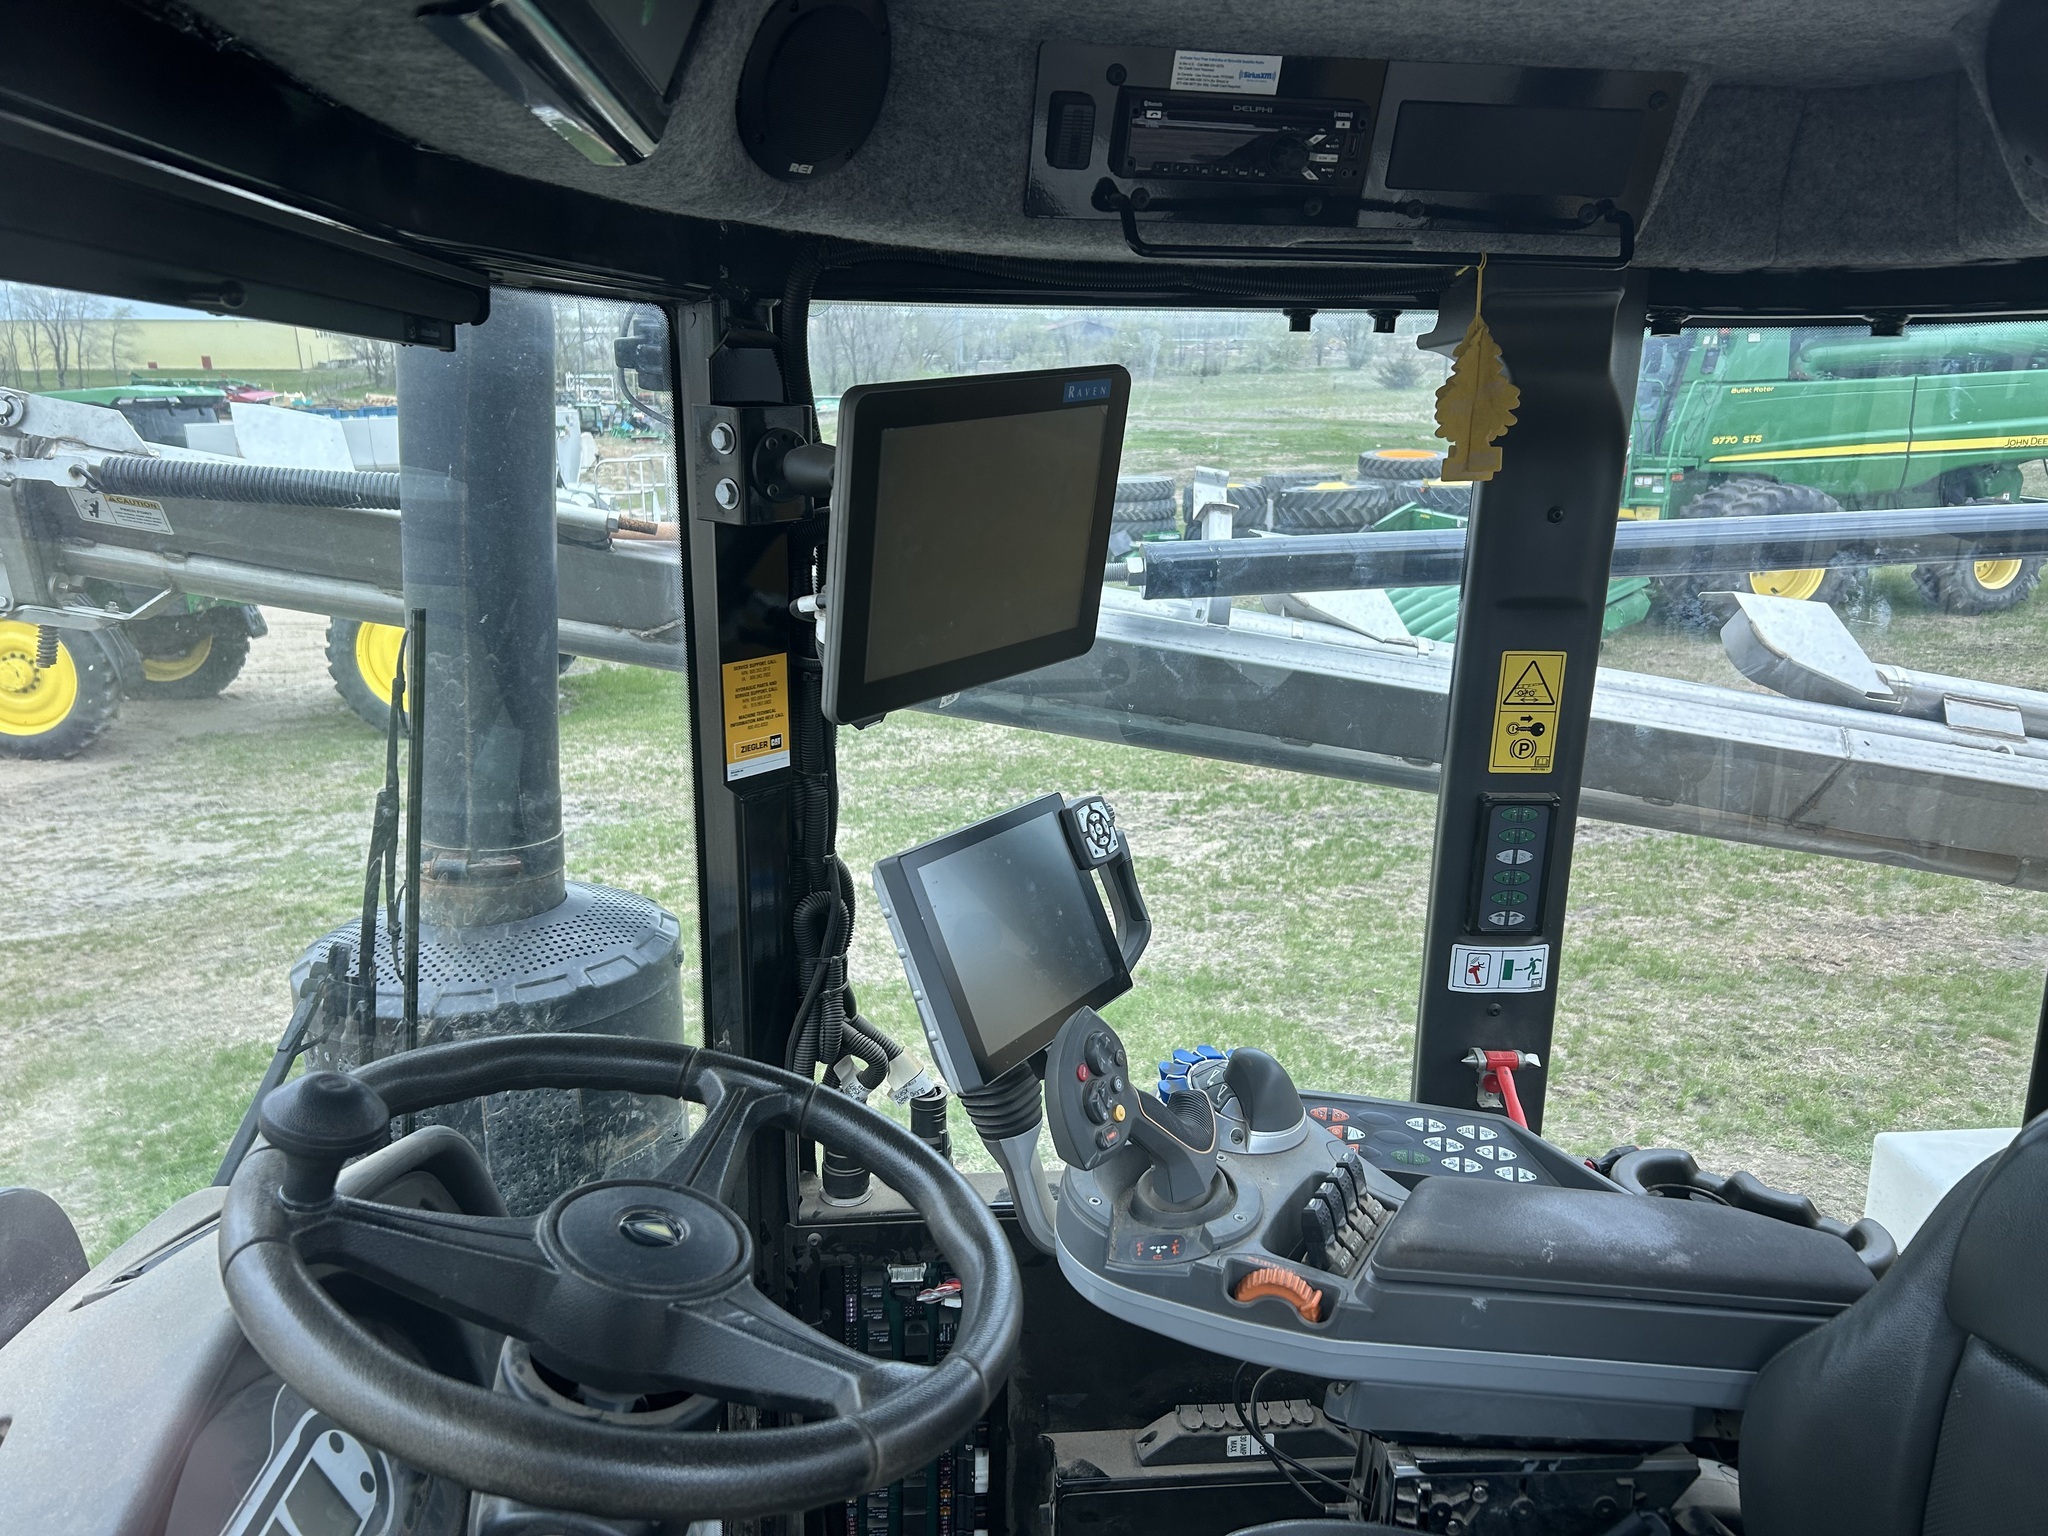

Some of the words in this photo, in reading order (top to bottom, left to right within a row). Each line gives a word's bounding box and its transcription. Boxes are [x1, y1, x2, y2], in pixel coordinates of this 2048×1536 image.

[1233, 104, 1273, 113] DELPHI
[789, 162, 814, 174] REI
[1730, 386, 1752, 394] Bullet
[1753, 385, 1775, 394] Rotor
[1712, 436, 1738, 445] 9770
[1742, 434, 1762, 444] STS
[2004, 438, 2029, 446] JOHN
[116, 496, 158, 509] CAUTION
[730, 718, 756, 728] INFORMATION
[741, 740, 768, 753] ZIEGLER
[771, 737, 781, 746] CAT
